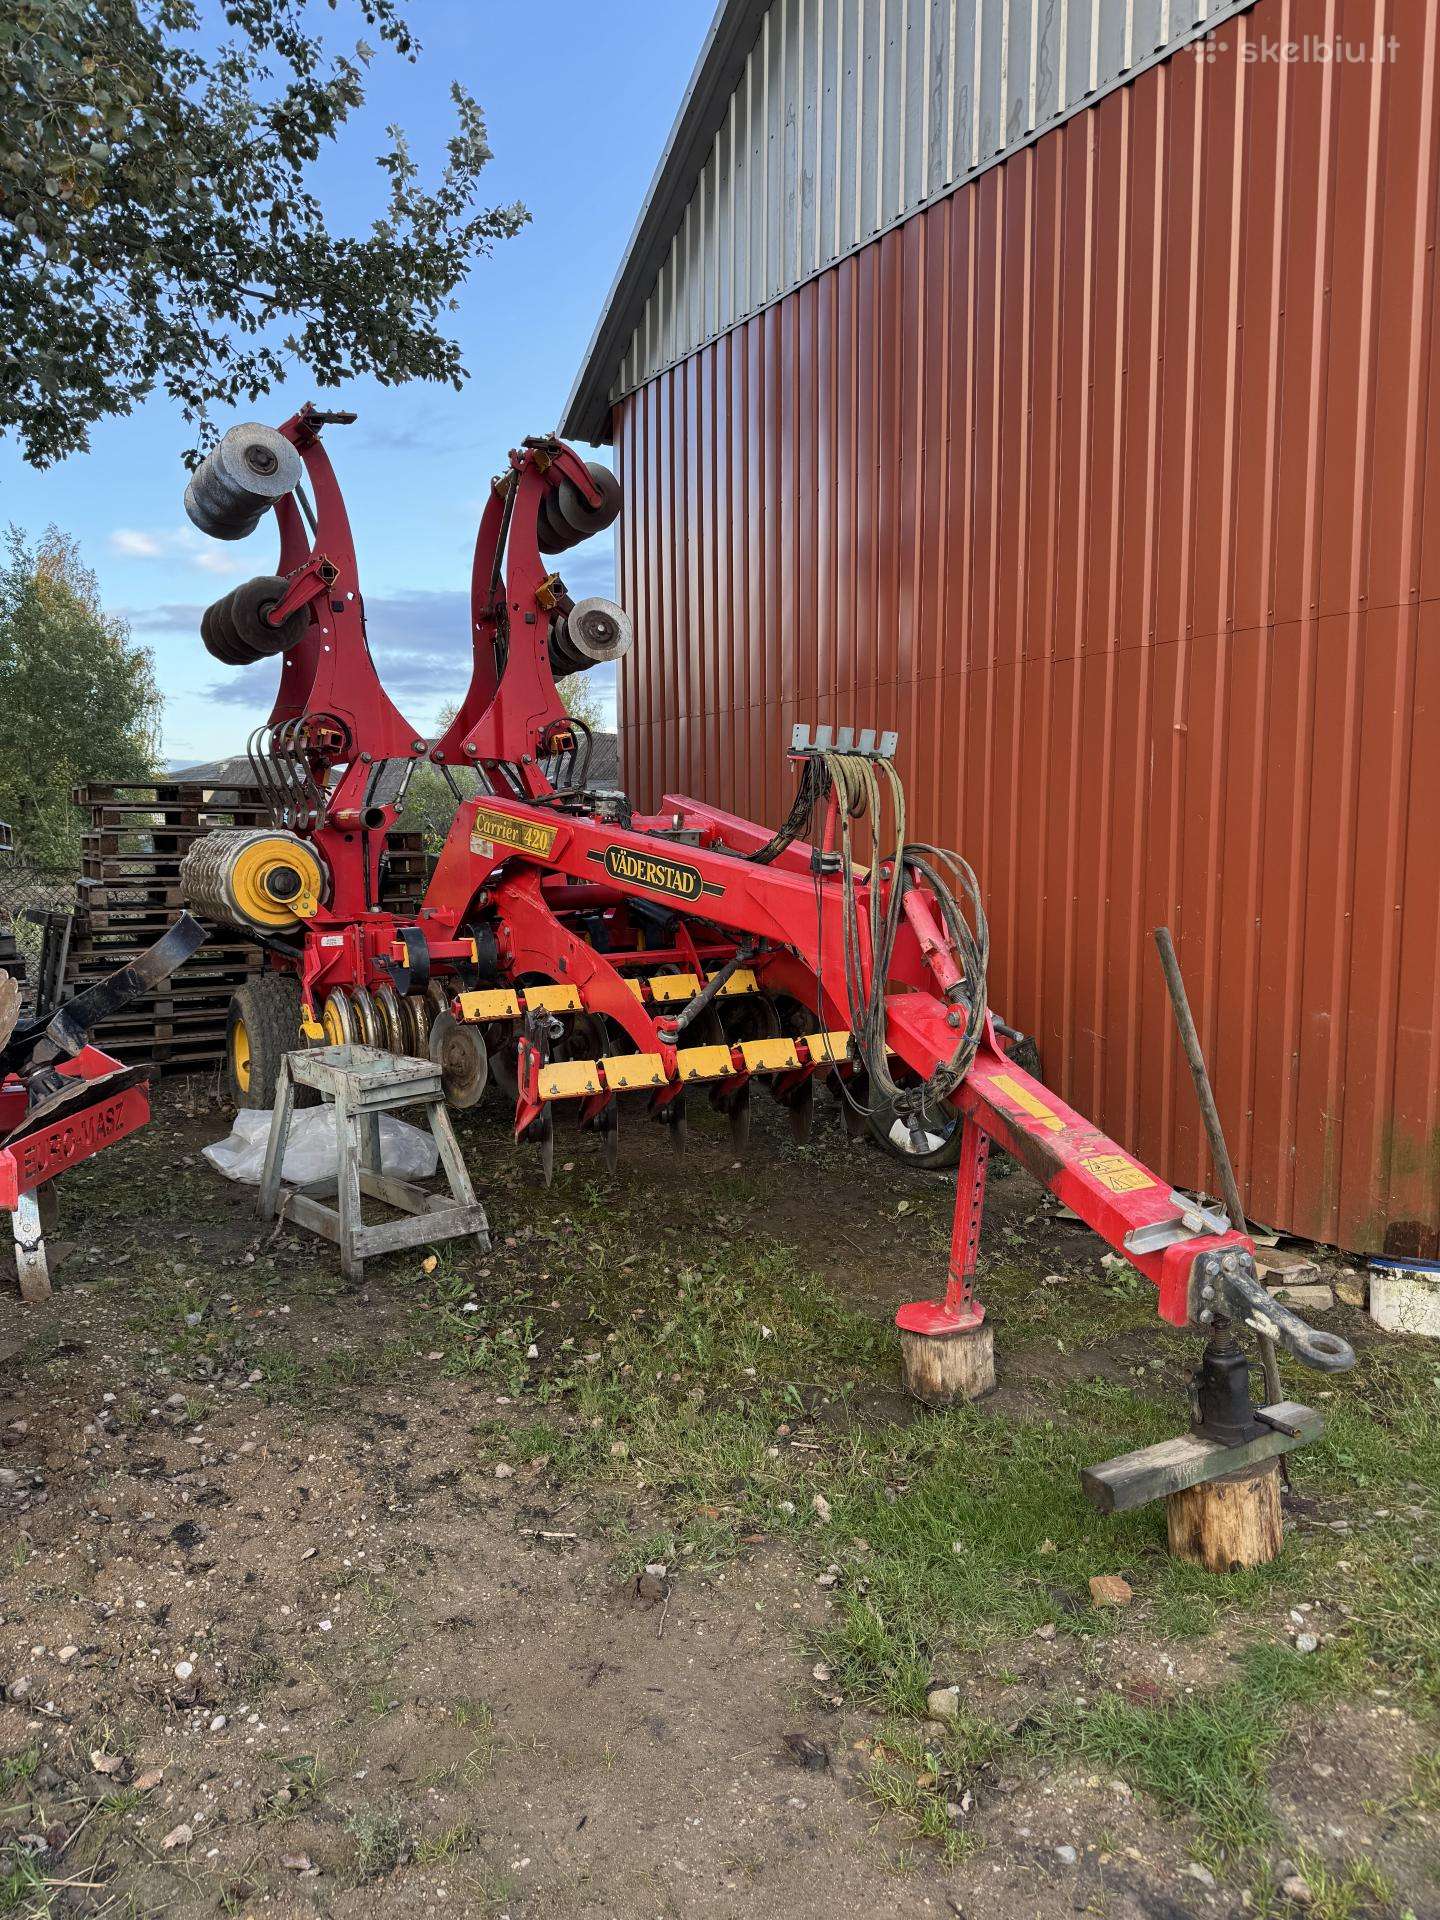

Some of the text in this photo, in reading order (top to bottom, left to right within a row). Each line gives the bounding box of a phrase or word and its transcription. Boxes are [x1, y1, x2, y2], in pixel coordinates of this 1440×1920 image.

[476, 813, 519, 841] Carrier
[524, 827, 548, 851] 420
[610, 849, 696, 893] VÄDERSTAD
